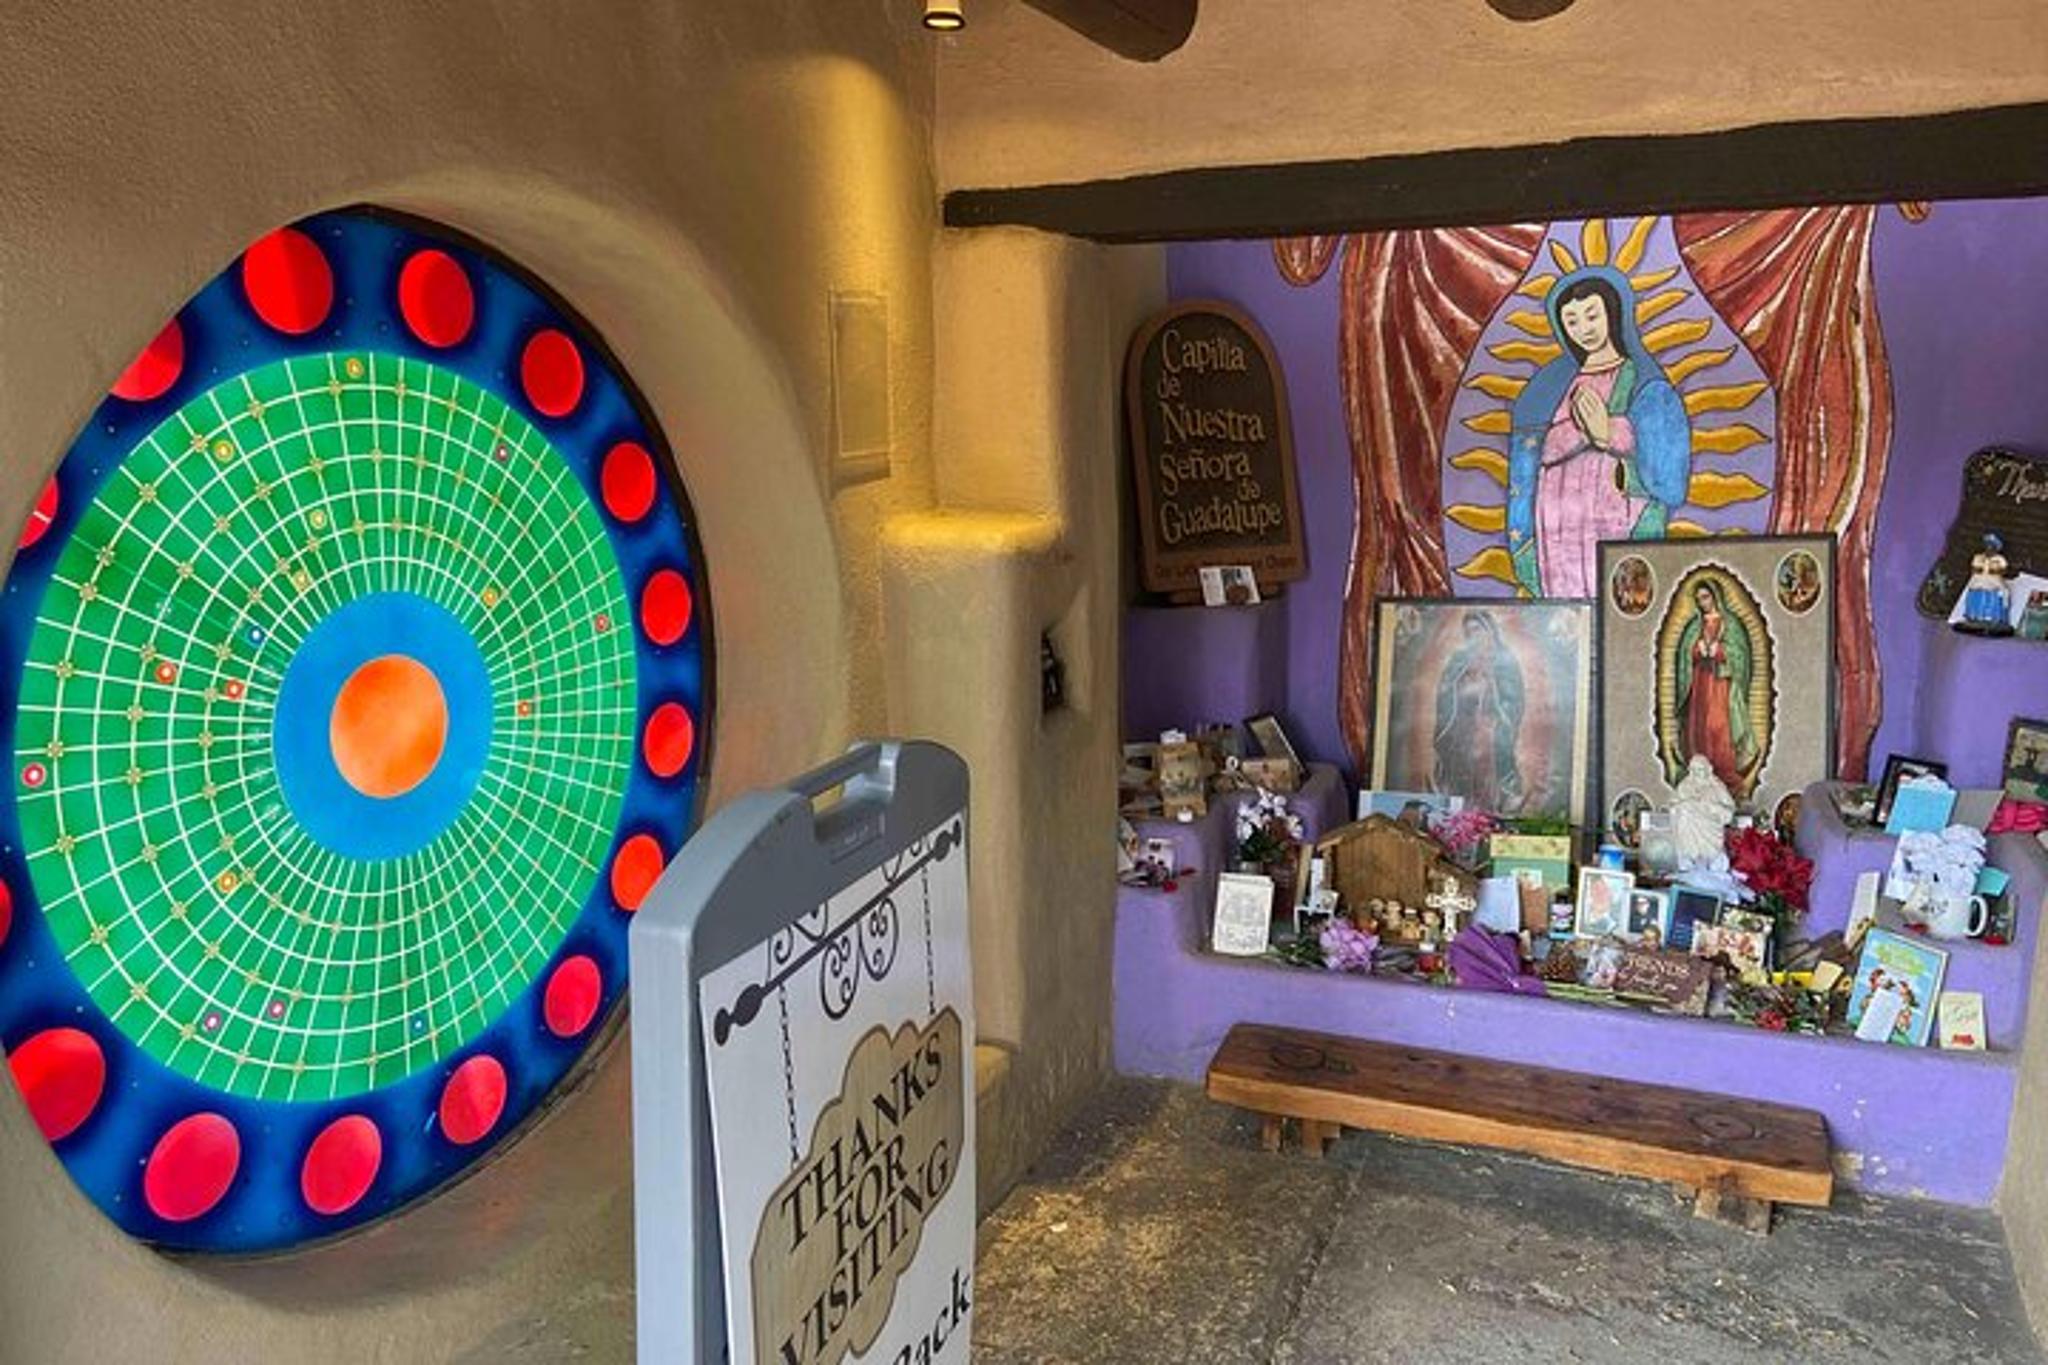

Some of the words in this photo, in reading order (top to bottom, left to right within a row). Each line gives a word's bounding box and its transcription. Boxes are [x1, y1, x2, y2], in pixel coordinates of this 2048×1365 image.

[1162, 329, 1247, 374] Capilla
[1157, 371, 1181, 399] de
[1160, 402, 1266, 445] Nuestra
[1160, 448, 1251, 496] Señora
[1236, 477, 1261, 500] de
[1160, 496, 1282, 544] Guadalupe
[780, 1032, 942, 1256] THANKS
[833, 1133, 908, 1269] FOR
[779, 1140, 949, 1365] VISITING
